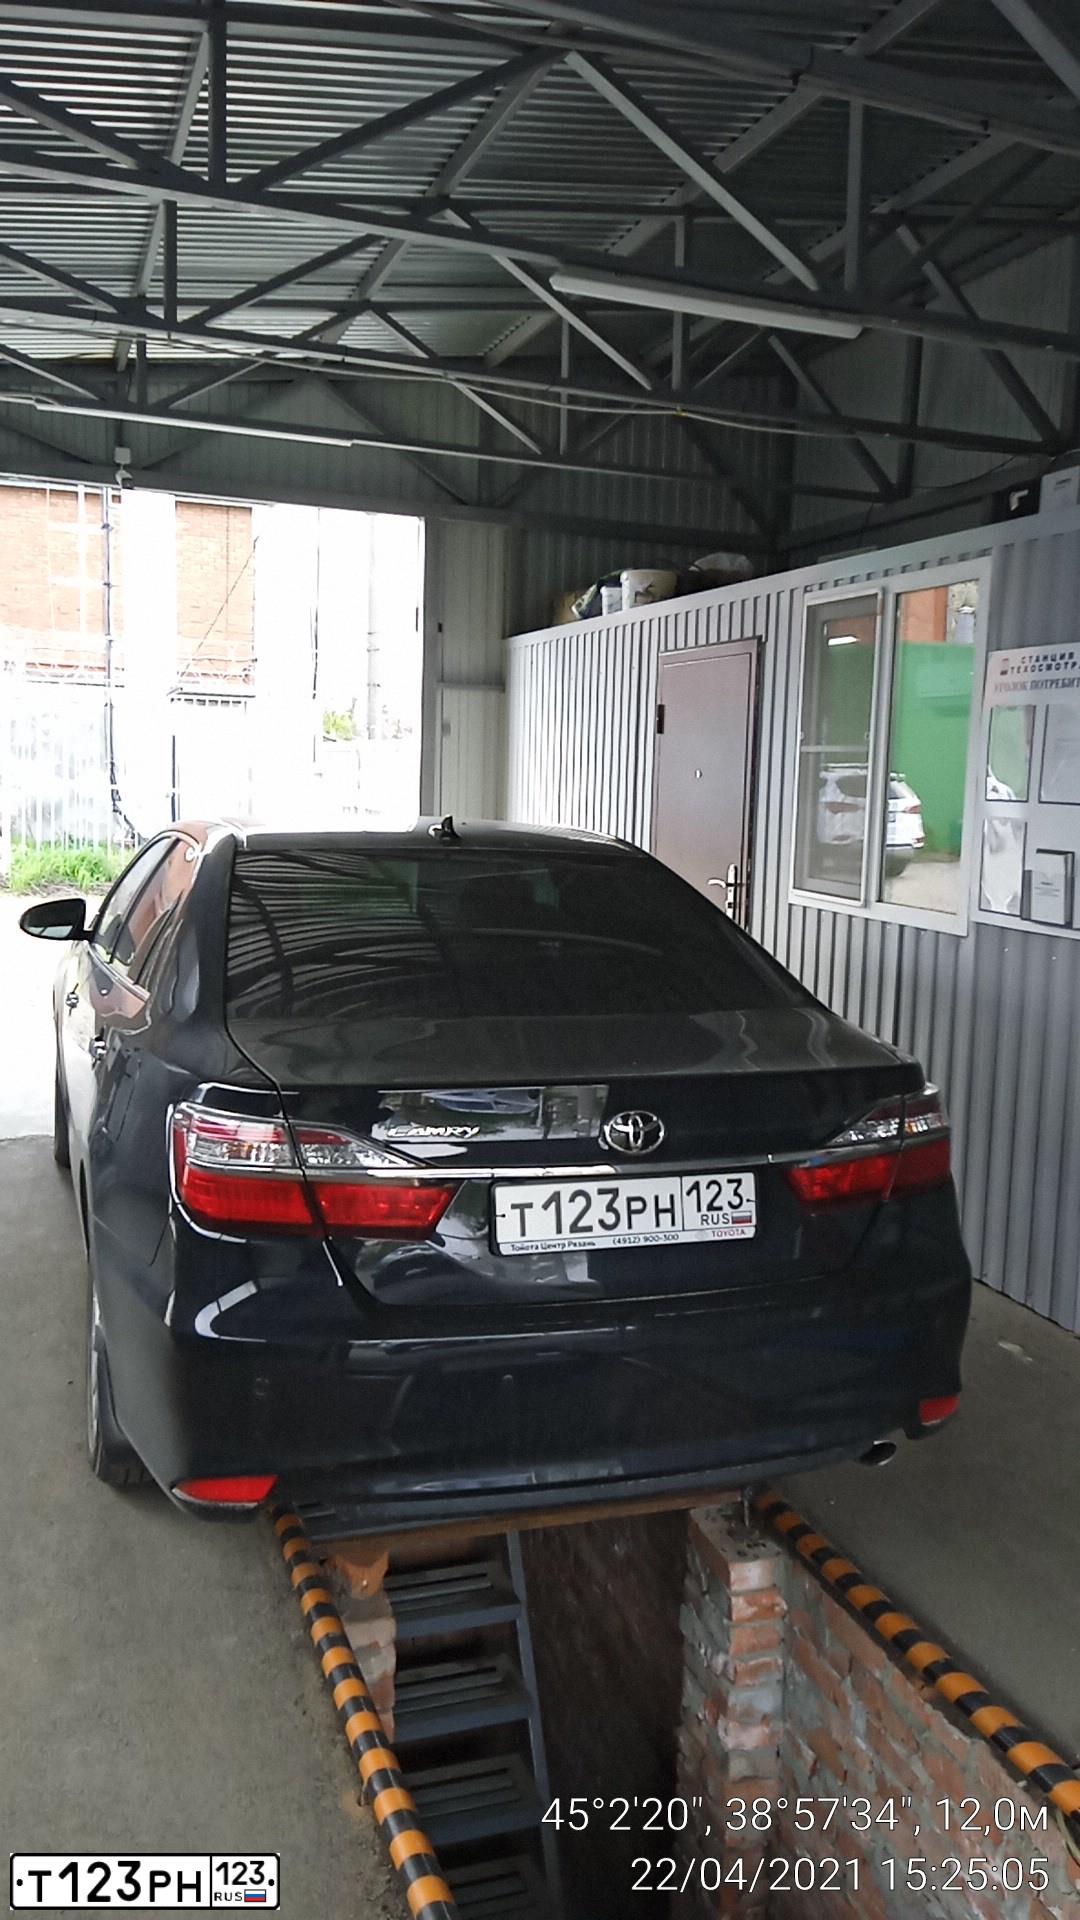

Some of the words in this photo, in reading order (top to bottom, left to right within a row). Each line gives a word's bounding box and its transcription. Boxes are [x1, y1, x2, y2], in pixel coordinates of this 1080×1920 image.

[1021, 652, 1074, 664] СТАНЦИЯ
[1010, 661, 1080, 674] ТЕХОСМОТР
[387, 1125, 479, 1138] CAMRY
[686, 1178, 743, 1213] 123
[700, 1212, 730, 1226] RUS
[711, 1230, 747, 1238] TOYOTA
[540, 1241, 566, 1251] Центр
